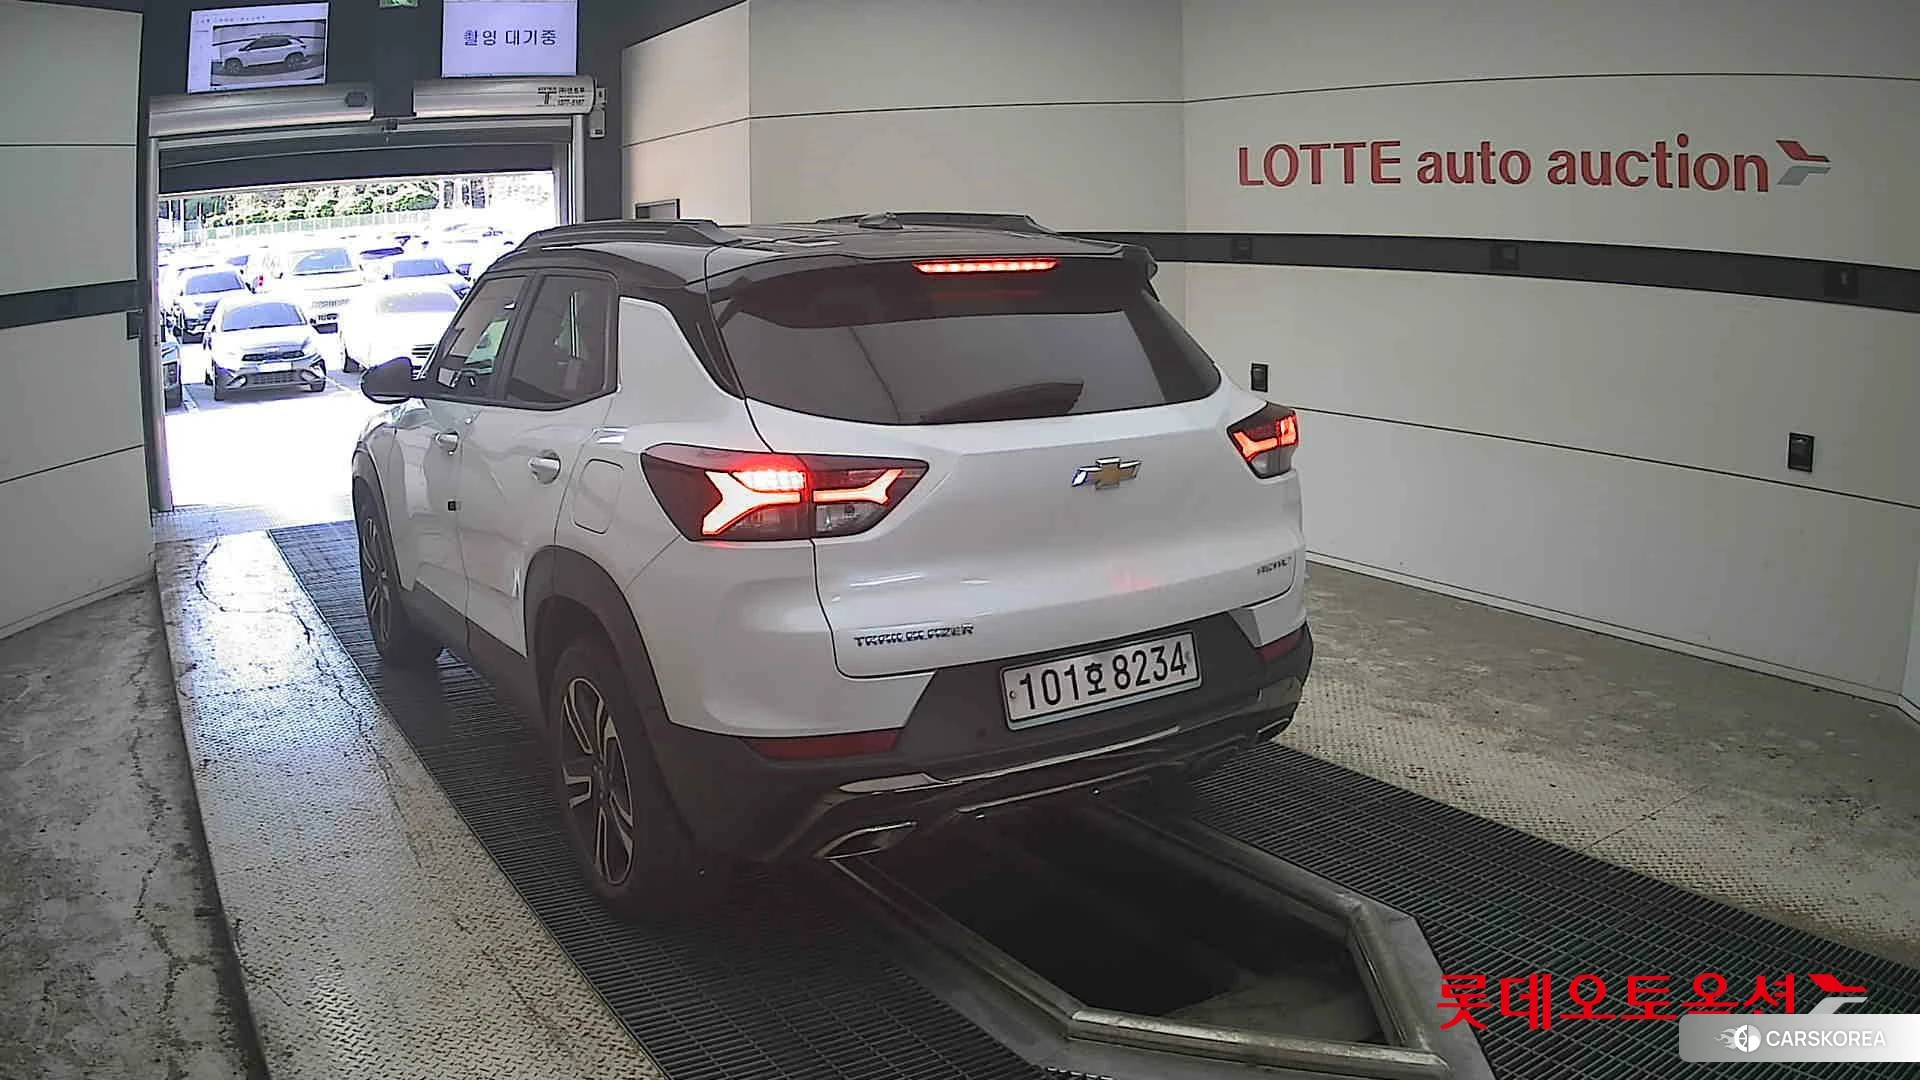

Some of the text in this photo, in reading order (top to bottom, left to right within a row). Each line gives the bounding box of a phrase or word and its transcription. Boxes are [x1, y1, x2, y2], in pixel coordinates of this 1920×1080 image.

[505, 29, 557, 46] 대기중
[1238, 133, 1770, 192] LOTTE auto auction
